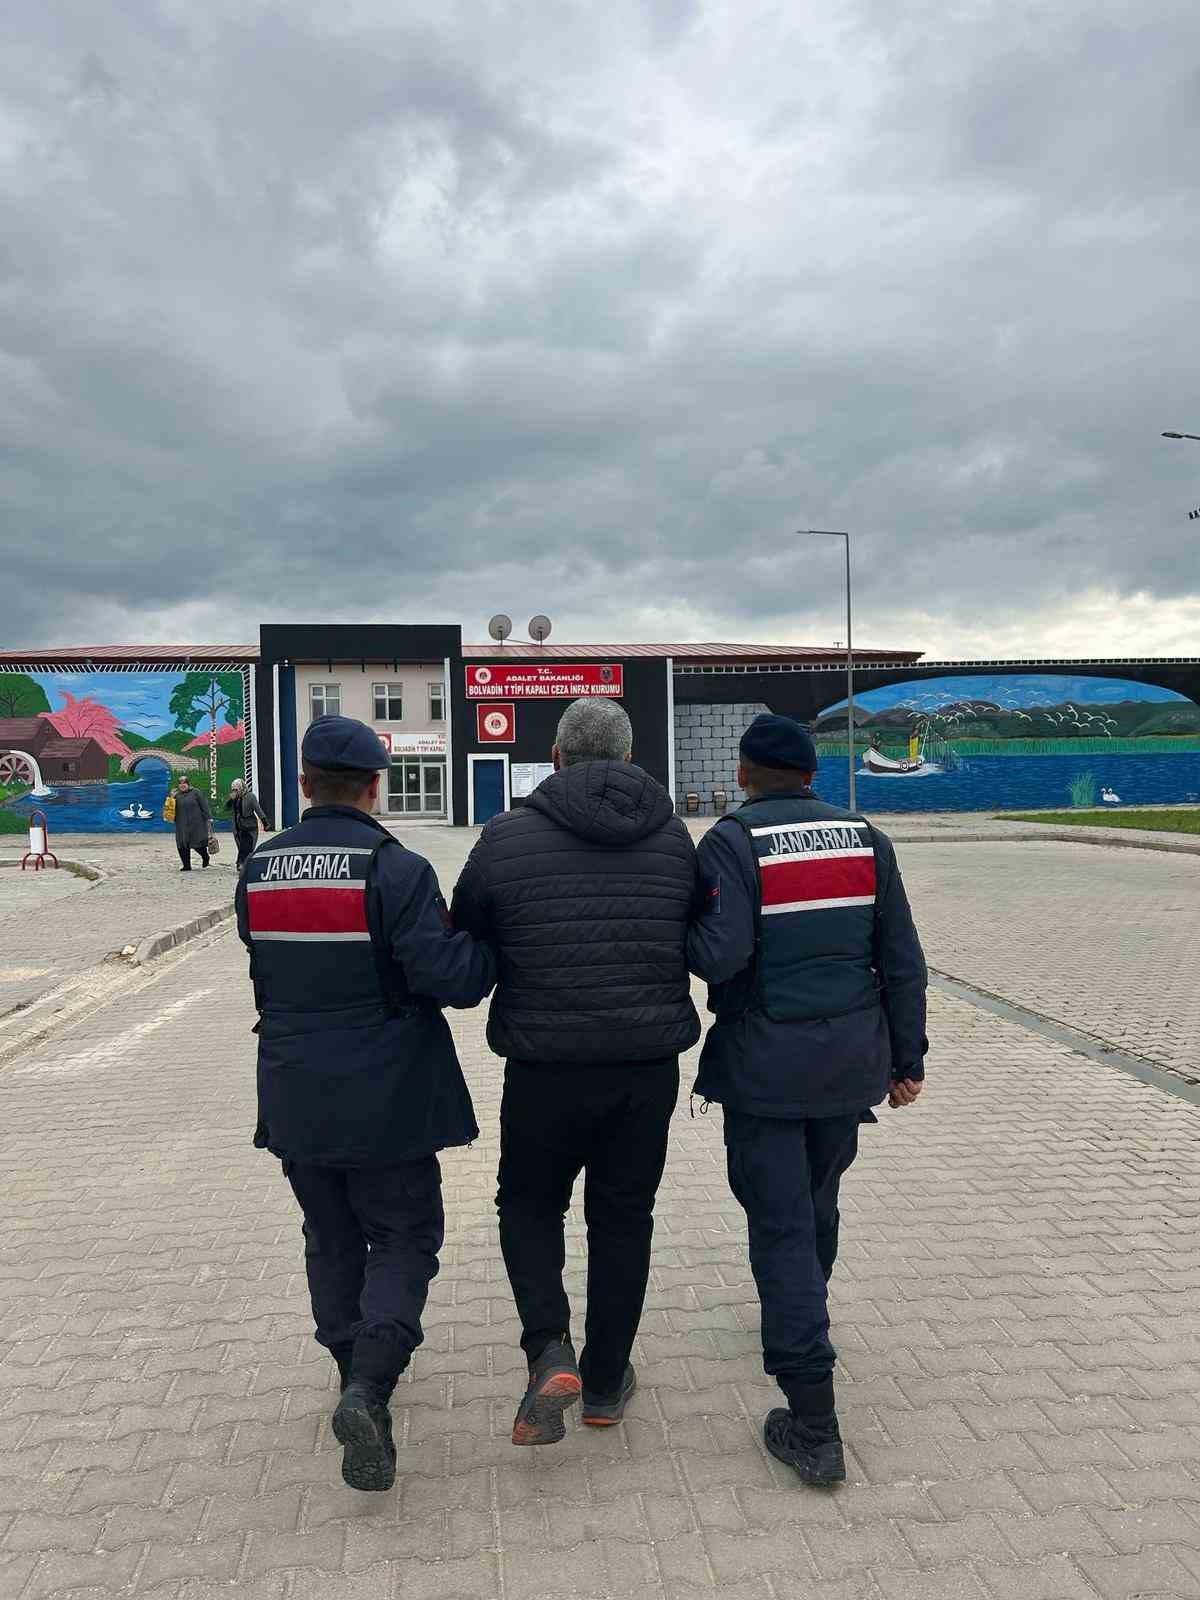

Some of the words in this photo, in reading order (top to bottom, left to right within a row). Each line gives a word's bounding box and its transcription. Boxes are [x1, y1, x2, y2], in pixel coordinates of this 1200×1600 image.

[469, 683, 503, 695] BOLVADİN
[504, 685, 510, 695] T
[511, 683, 524, 695] TİPİ
[525, 684, 550, 695] KAPALI
[550, 684, 569, 695] CEZA
[570, 682, 590, 694] İNFAZ
[590, 684, 620, 694] KURUMU
[768, 828, 863, 855] JANDARMA
[260, 854, 351, 881] JANDARMA
